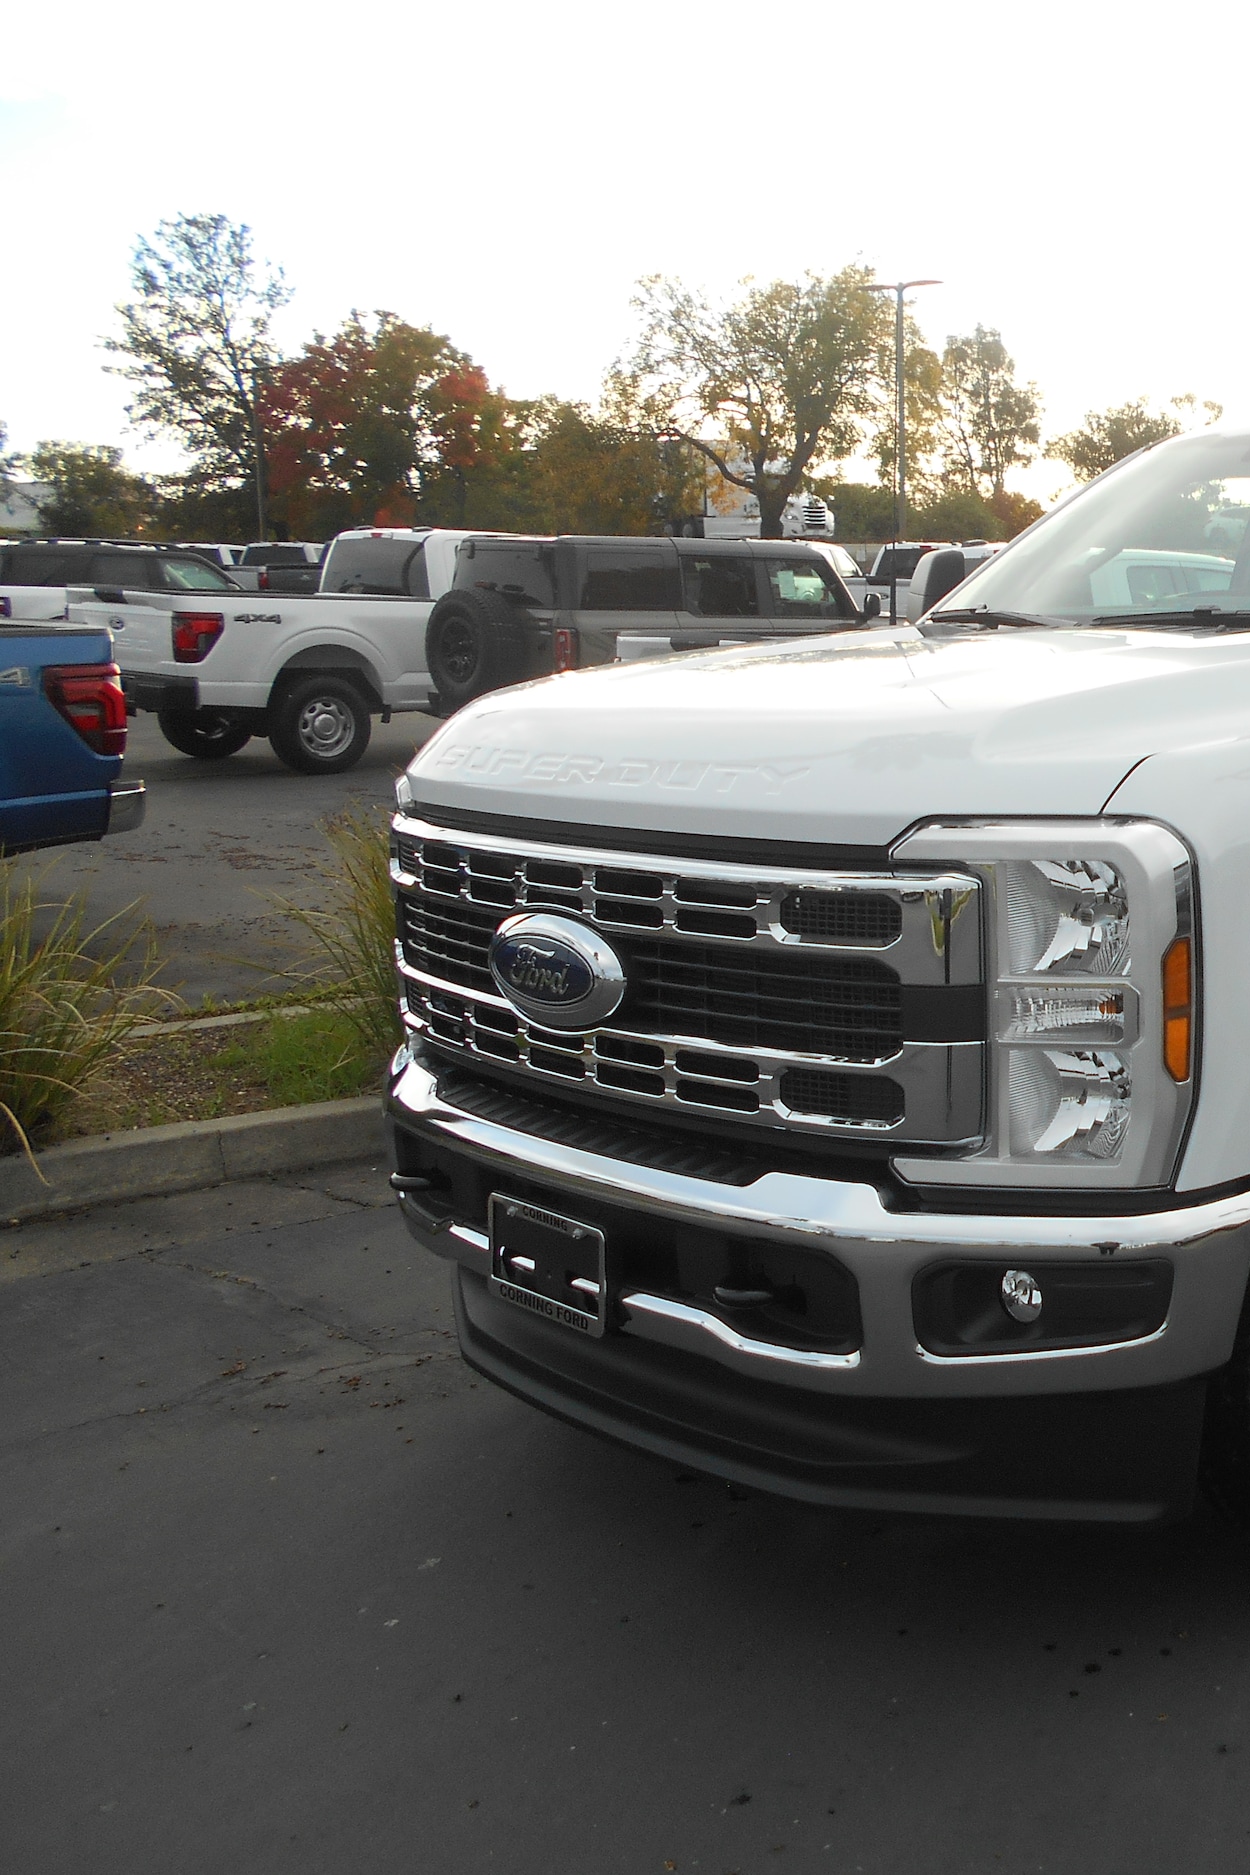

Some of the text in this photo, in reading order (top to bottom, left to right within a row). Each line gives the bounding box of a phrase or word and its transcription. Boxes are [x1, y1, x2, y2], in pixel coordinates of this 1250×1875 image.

[435, 743, 811, 795] SUPER DUTY
[510, 943, 571, 995] Ford
[523, 1206, 568, 1231] CORNING
[500, 1283, 588, 1330] CORNING FORD
